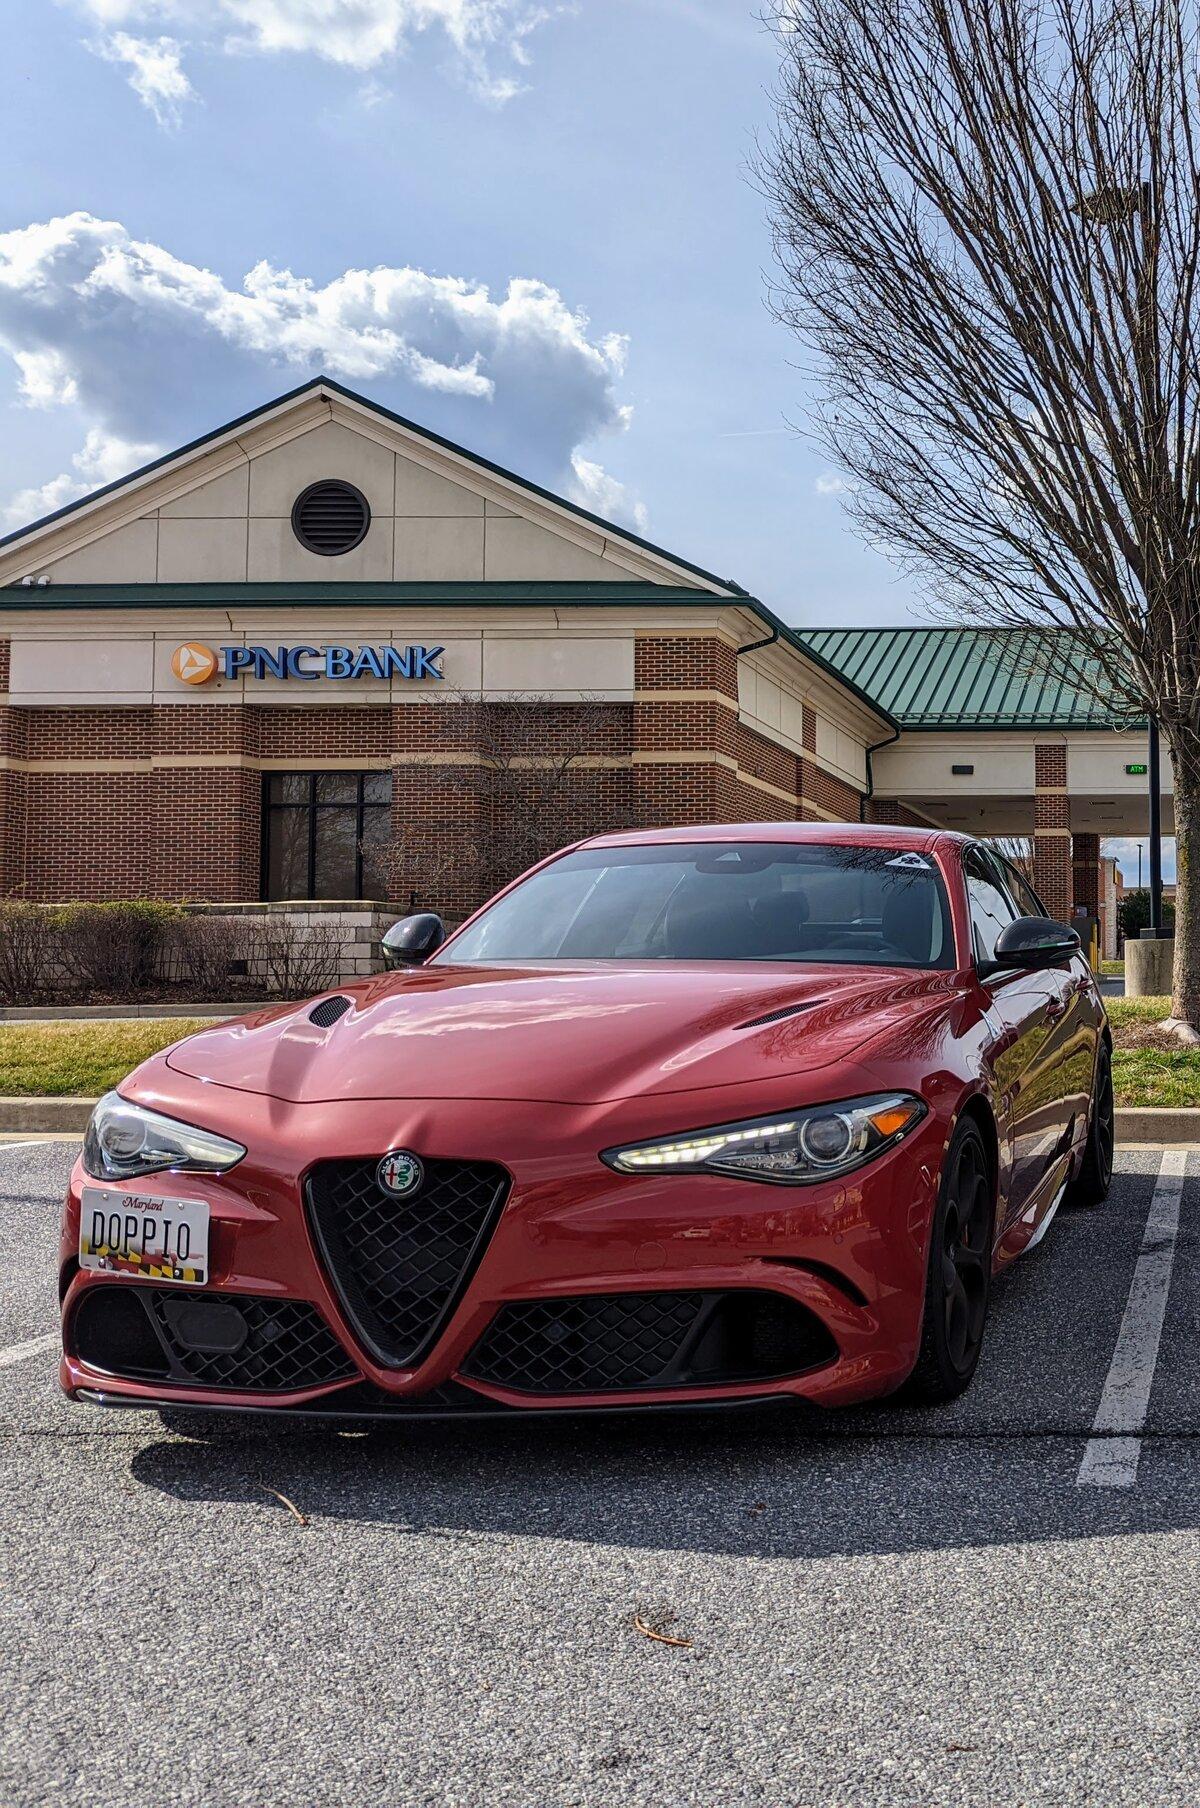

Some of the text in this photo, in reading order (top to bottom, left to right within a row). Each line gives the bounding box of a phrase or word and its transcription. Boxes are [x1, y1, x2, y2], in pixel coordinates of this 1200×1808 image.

[381, 1154, 419, 1176] ALFA ROMEO
[122, 1196, 164, 1213] Maryland
[91, 1210, 191, 1261] DOPPIO
